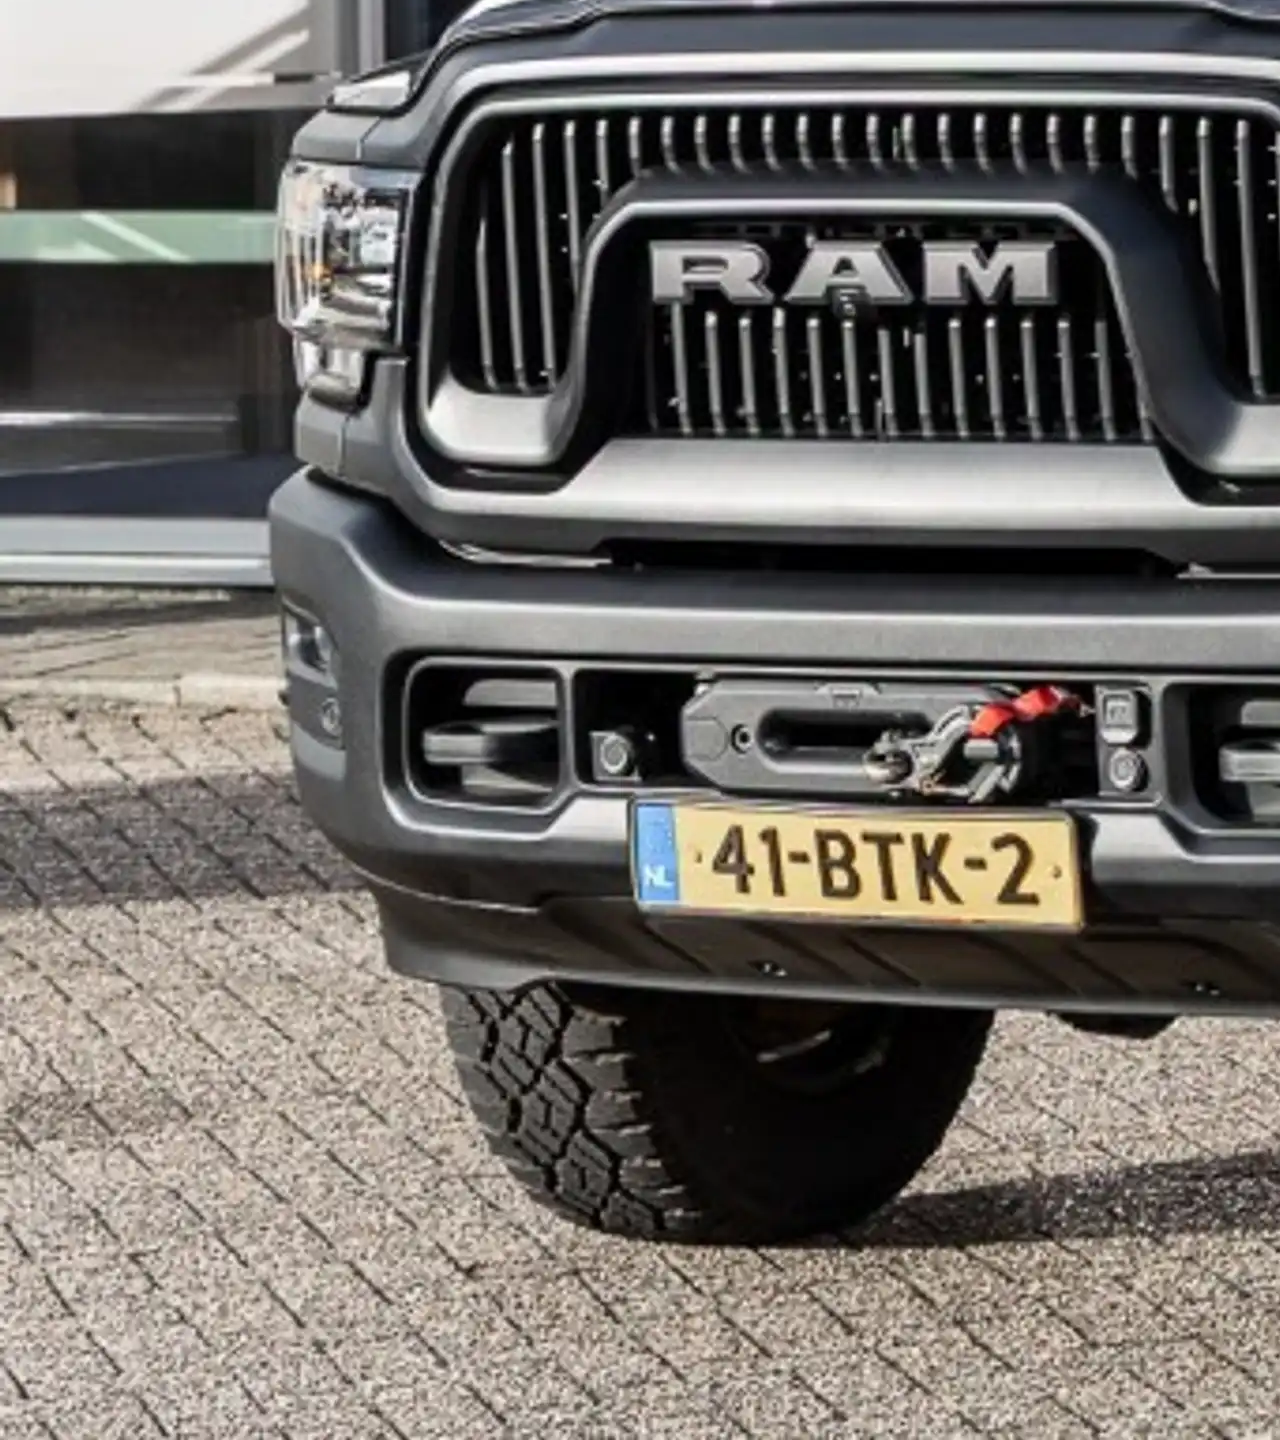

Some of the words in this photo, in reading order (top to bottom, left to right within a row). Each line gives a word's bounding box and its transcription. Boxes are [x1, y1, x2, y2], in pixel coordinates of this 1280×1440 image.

[649, 240, 1059, 306] RAM
[642, 864, 675, 888] NL
[711, 824, 1040, 906] 41-BTK-2
